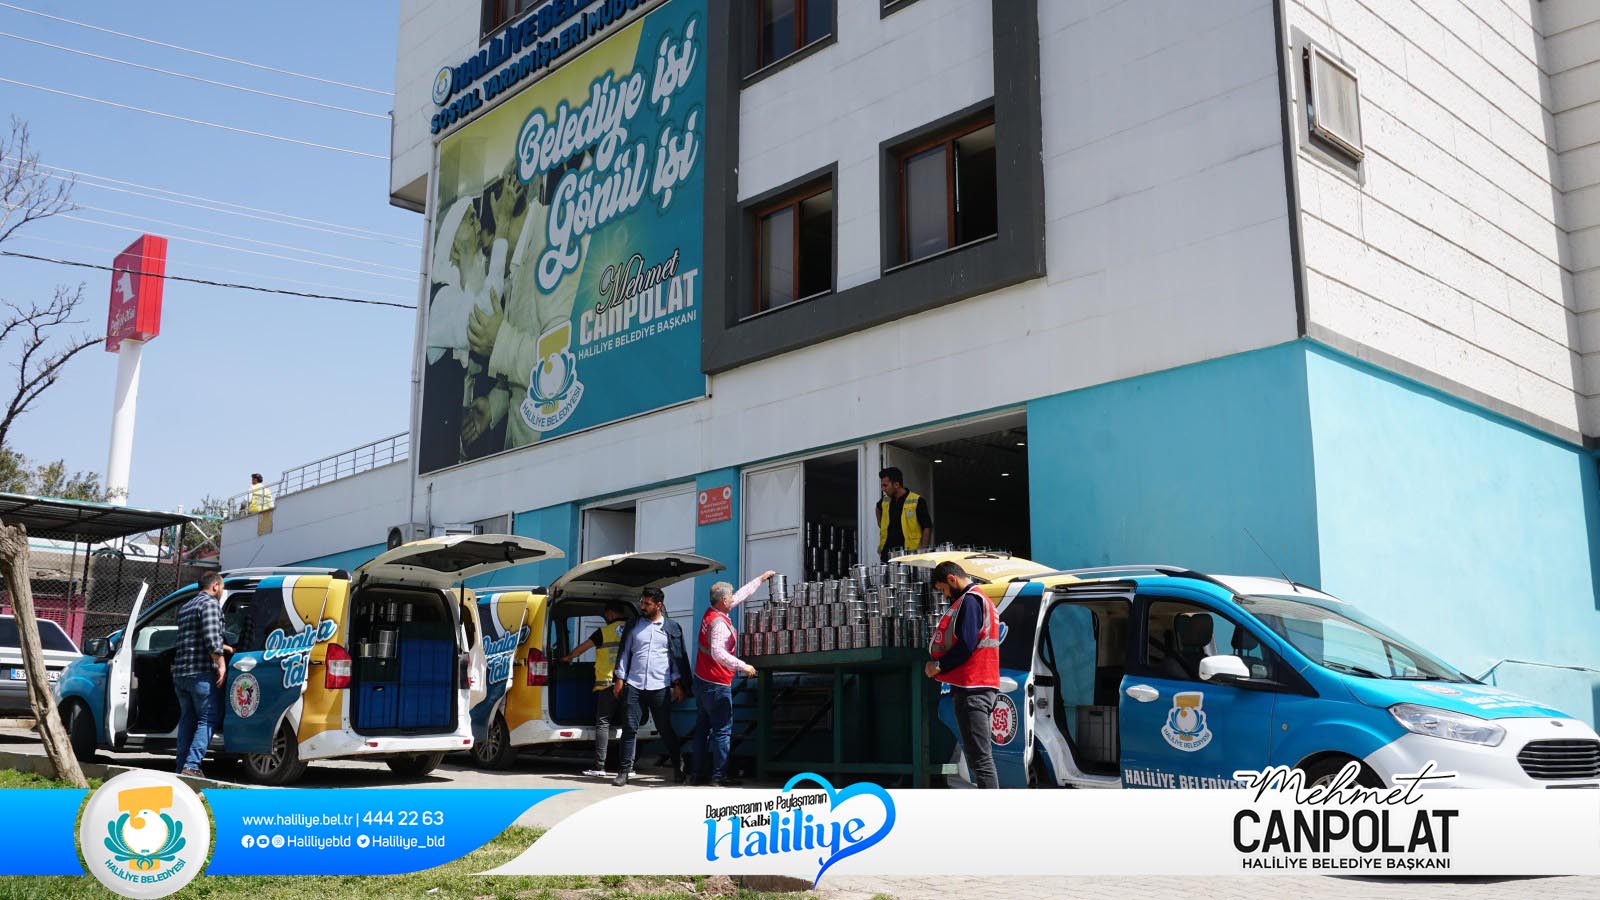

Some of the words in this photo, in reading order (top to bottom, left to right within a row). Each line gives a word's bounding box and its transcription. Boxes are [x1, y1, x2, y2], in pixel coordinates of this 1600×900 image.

[430, 88, 483, 134] SOSYAL
[483, 55, 538, 101] YARDIM
[536, 12, 588, 68] İŞLERİ
[453, 14, 539, 94] HALİLİYE
[520, 72, 645, 180] Belediye
[652, 19, 697, 116] işi
[539, 144, 647, 289] Gönül
[653, 111, 698, 208] işi
[579, 269, 698, 346] CANPOLAT
[596, 248, 679, 314] Mehmet
[578, 340, 613, 360] HALİLİYE
[615, 326, 655, 347] BELEDİYE
[657, 310, 697, 332] BAŞKANI
[522, 403, 546, 427] HALİLİYE
[1125, 768, 1176, 789] HALİLİYE
[1179, 774, 1248, 789] BELEDİYES
